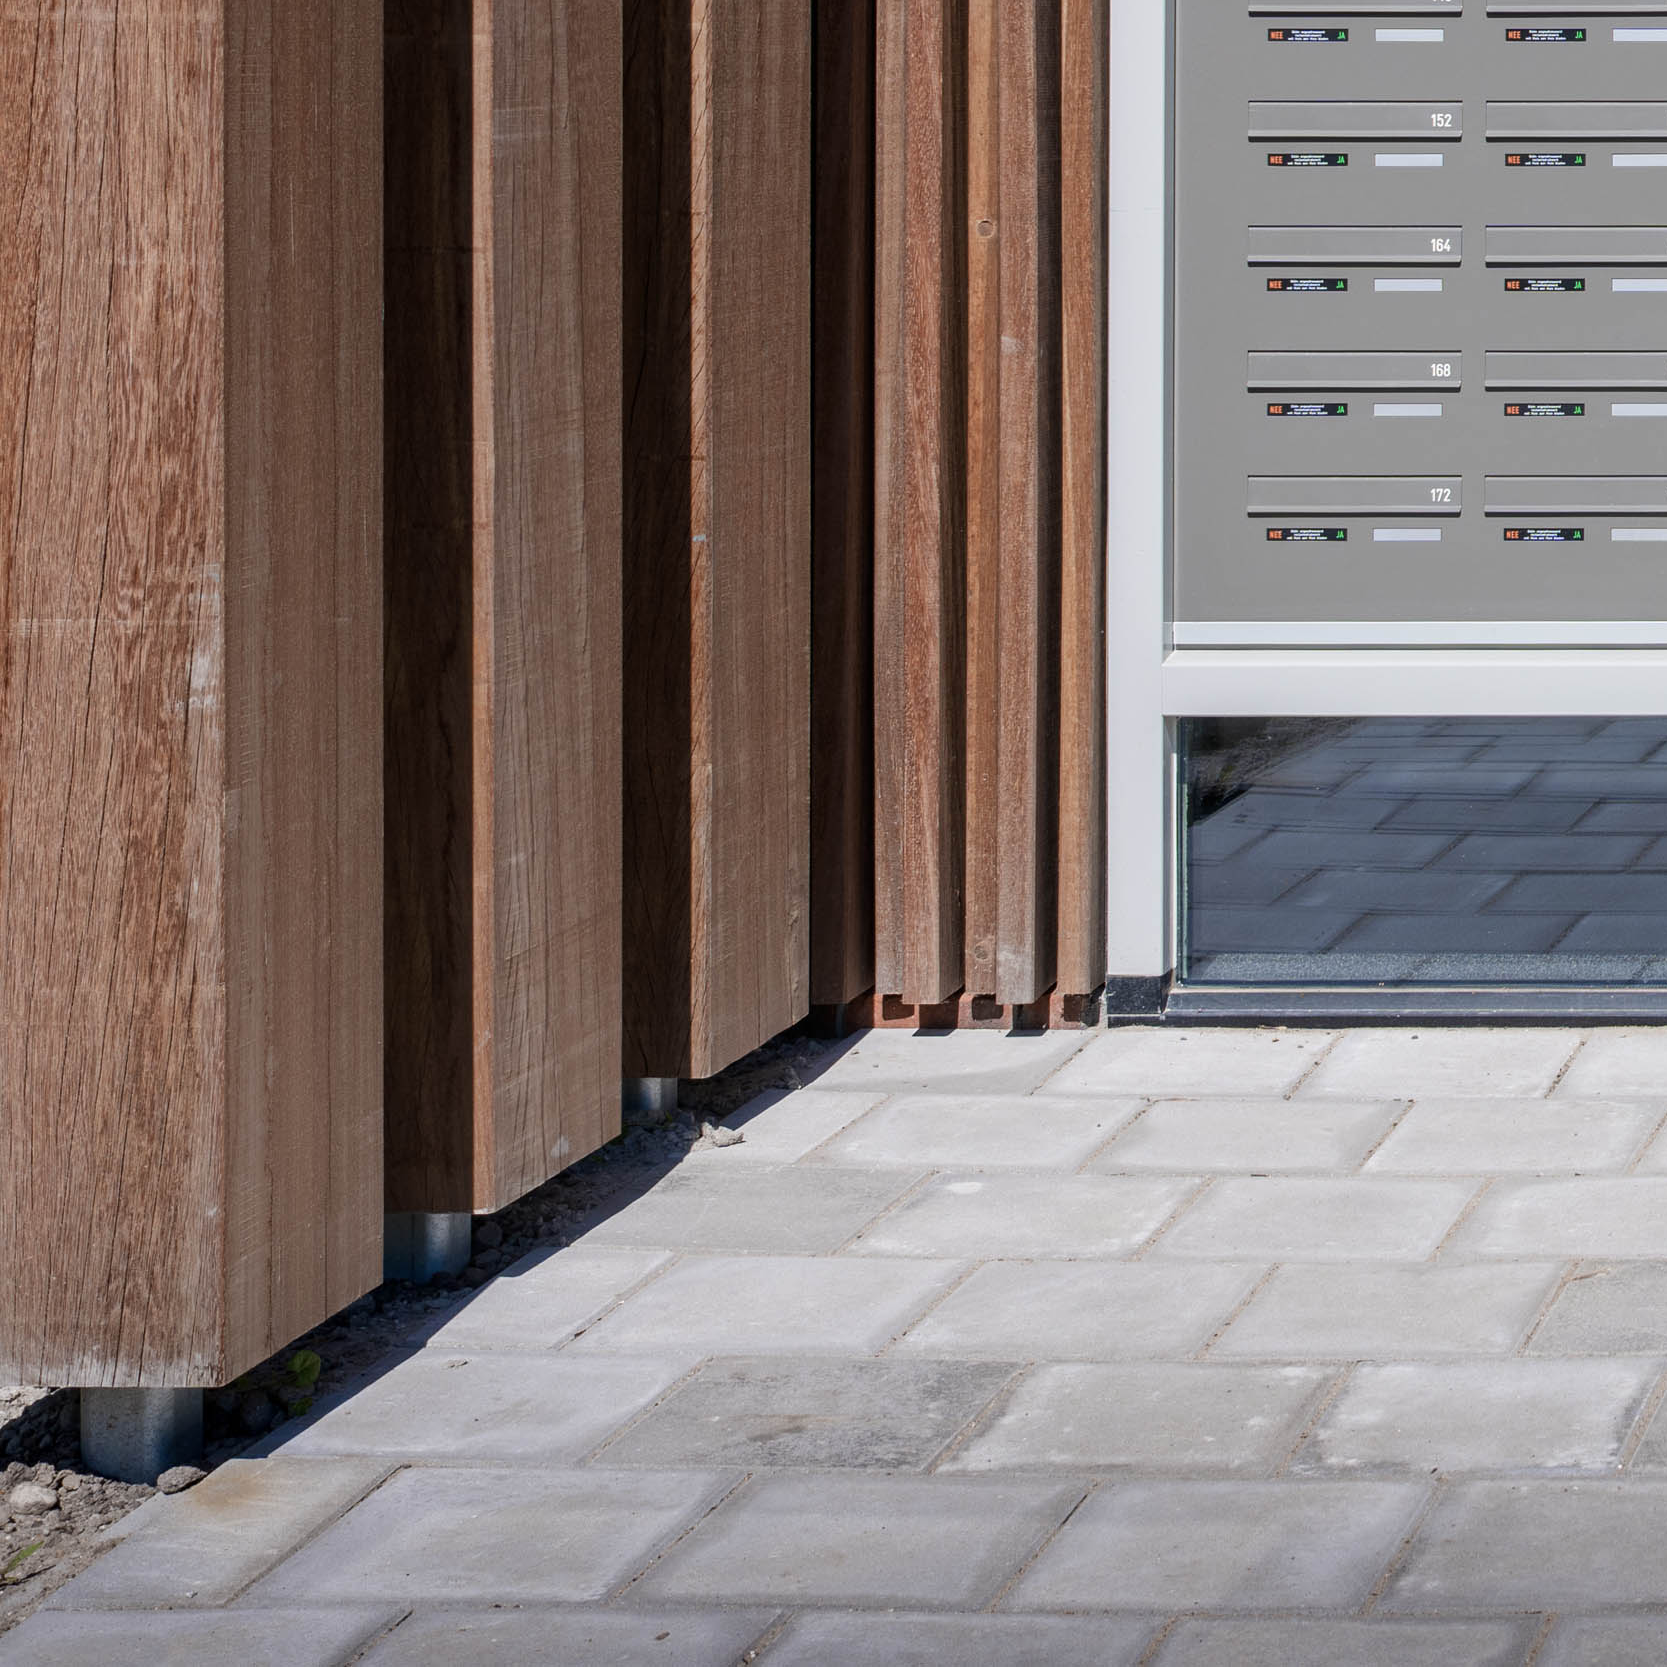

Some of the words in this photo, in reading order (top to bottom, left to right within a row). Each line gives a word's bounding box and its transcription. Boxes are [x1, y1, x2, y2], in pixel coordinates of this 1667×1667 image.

[1270, 31, 1283, 39] NEE
[1337, 31, 1345, 39] JA
[1508, 31, 1520, 39] NEE
[1576, 31, 1584, 39] JA
[1431, 113, 1452, 127] 152
[1270, 156, 1283, 164] NEE
[1336, 156, 1344, 164] JA
[1508, 156, 1520, 164] NEE
[1576, 156, 1584, 164] JA
[1430, 238, 1451, 252] 164
[1269, 281, 1282, 289] NEE
[1336, 281, 1344, 289] JA
[1507, 281, 1520, 289] NEE
[1574, 281, 1582, 289] JA
[1430, 363, 1451, 377] 168
[1270, 406, 1282, 414] NEE
[1336, 406, 1344, 414] JA
[1507, 406, 1519, 414] NEE
[1574, 406, 1582, 414] JA
[1430, 488, 1451, 502] 172
[1269, 530, 1282, 539] NEE
[1336, 530, 1344, 538] JA
[1506, 531, 1518, 539] NEE
[1574, 531, 1582, 539] JA
